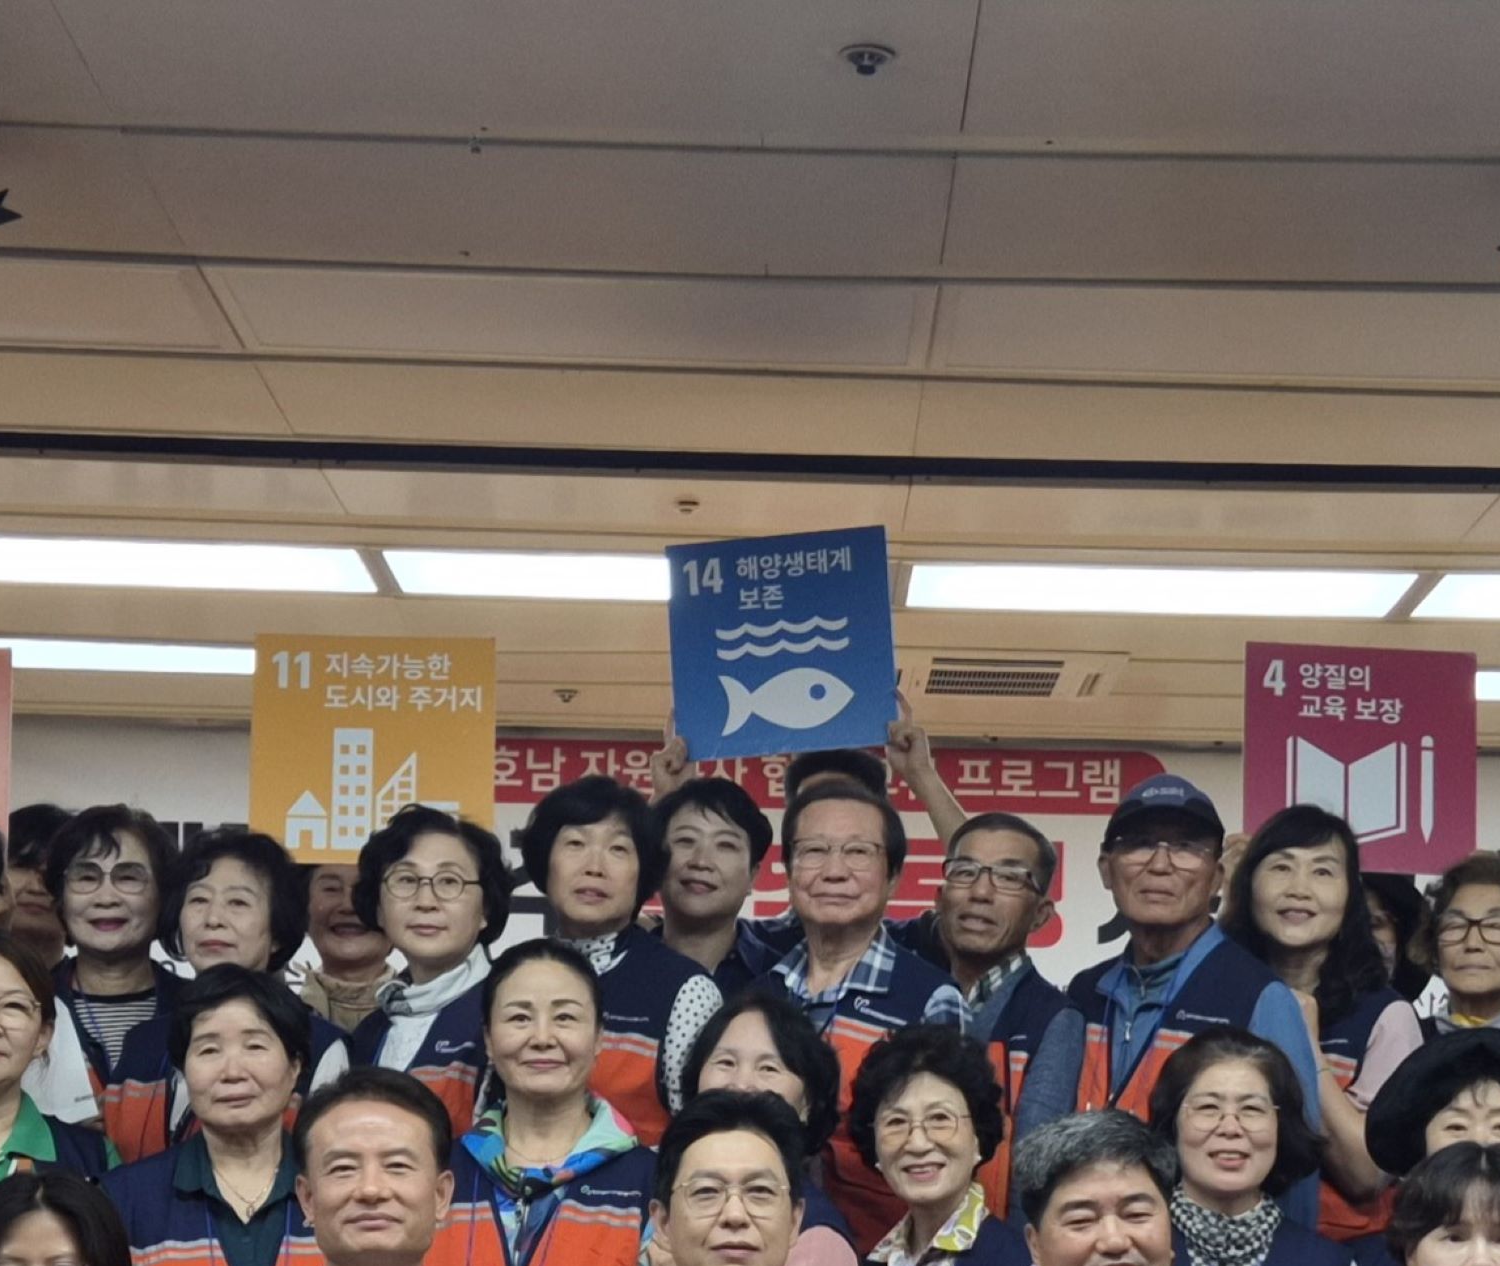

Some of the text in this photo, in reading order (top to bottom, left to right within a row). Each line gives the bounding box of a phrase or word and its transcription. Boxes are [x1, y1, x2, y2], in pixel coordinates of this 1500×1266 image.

[682, 558, 724, 596] 14
[736, 546, 852, 580] 해양생태계
[738, 584, 784, 610] 보존
[272, 651, 311, 689] 11
[325, 653, 452, 680] 지속가능한
[1263, 660, 1286, 696] 4
[1299, 663, 1370, 692] 양질의
[324, 685, 483, 712] 도시와 주거지
[1298, 695, 1404, 724] 교육 보장
[579, 750, 747, 788] 자원사
[953, 758, 1121, 804] 프로그램
